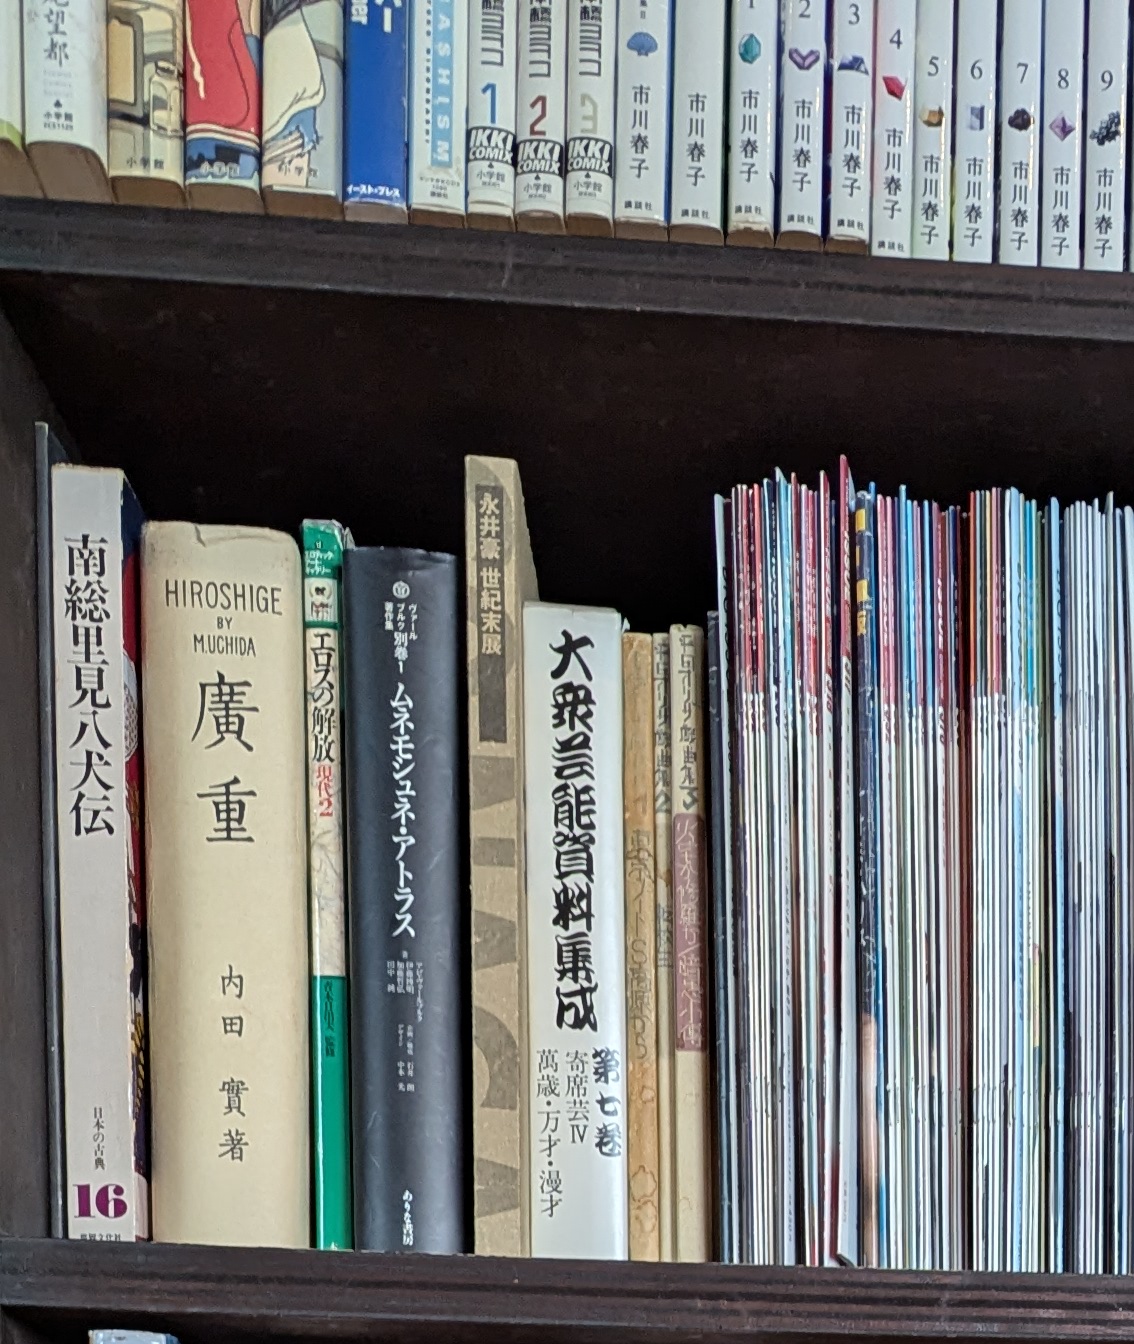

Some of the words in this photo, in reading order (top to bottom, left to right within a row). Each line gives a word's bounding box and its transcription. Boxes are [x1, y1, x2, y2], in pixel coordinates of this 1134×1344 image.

[889, 29, 903, 50] 4
[927, 56, 941, 77] 5
[1016, 62, 1029, 84] 7
[470, 128, 514, 150] IKKI
[529, 95, 547, 136] 2
[629, 85, 651, 179] 市川春子
[469, 147, 513, 164] COMIX
[792, 99, 814, 193] 市川春子
[1050, 166, 1072, 257] 市川春子
[479, 492, 502, 561] 永井豪
[165, 579, 284, 616] HIROSHIGE
[216, 616, 233, 630] BY
[480, 567, 503, 656] 世紀末展
[193, 634, 257, 657] M.UCHIDA
[64, 534, 115, 838] 南総里見八犬伝
[310, 632, 338, 764] エロスの解放
[389, 682, 417, 938] ムネモシュネ・アトラス
[549, 629, 600, 1032] 大衆芸能資料集成
[92, 1106, 106, 1171] 日本の古典
[72, 1183, 128, 1219] 16
